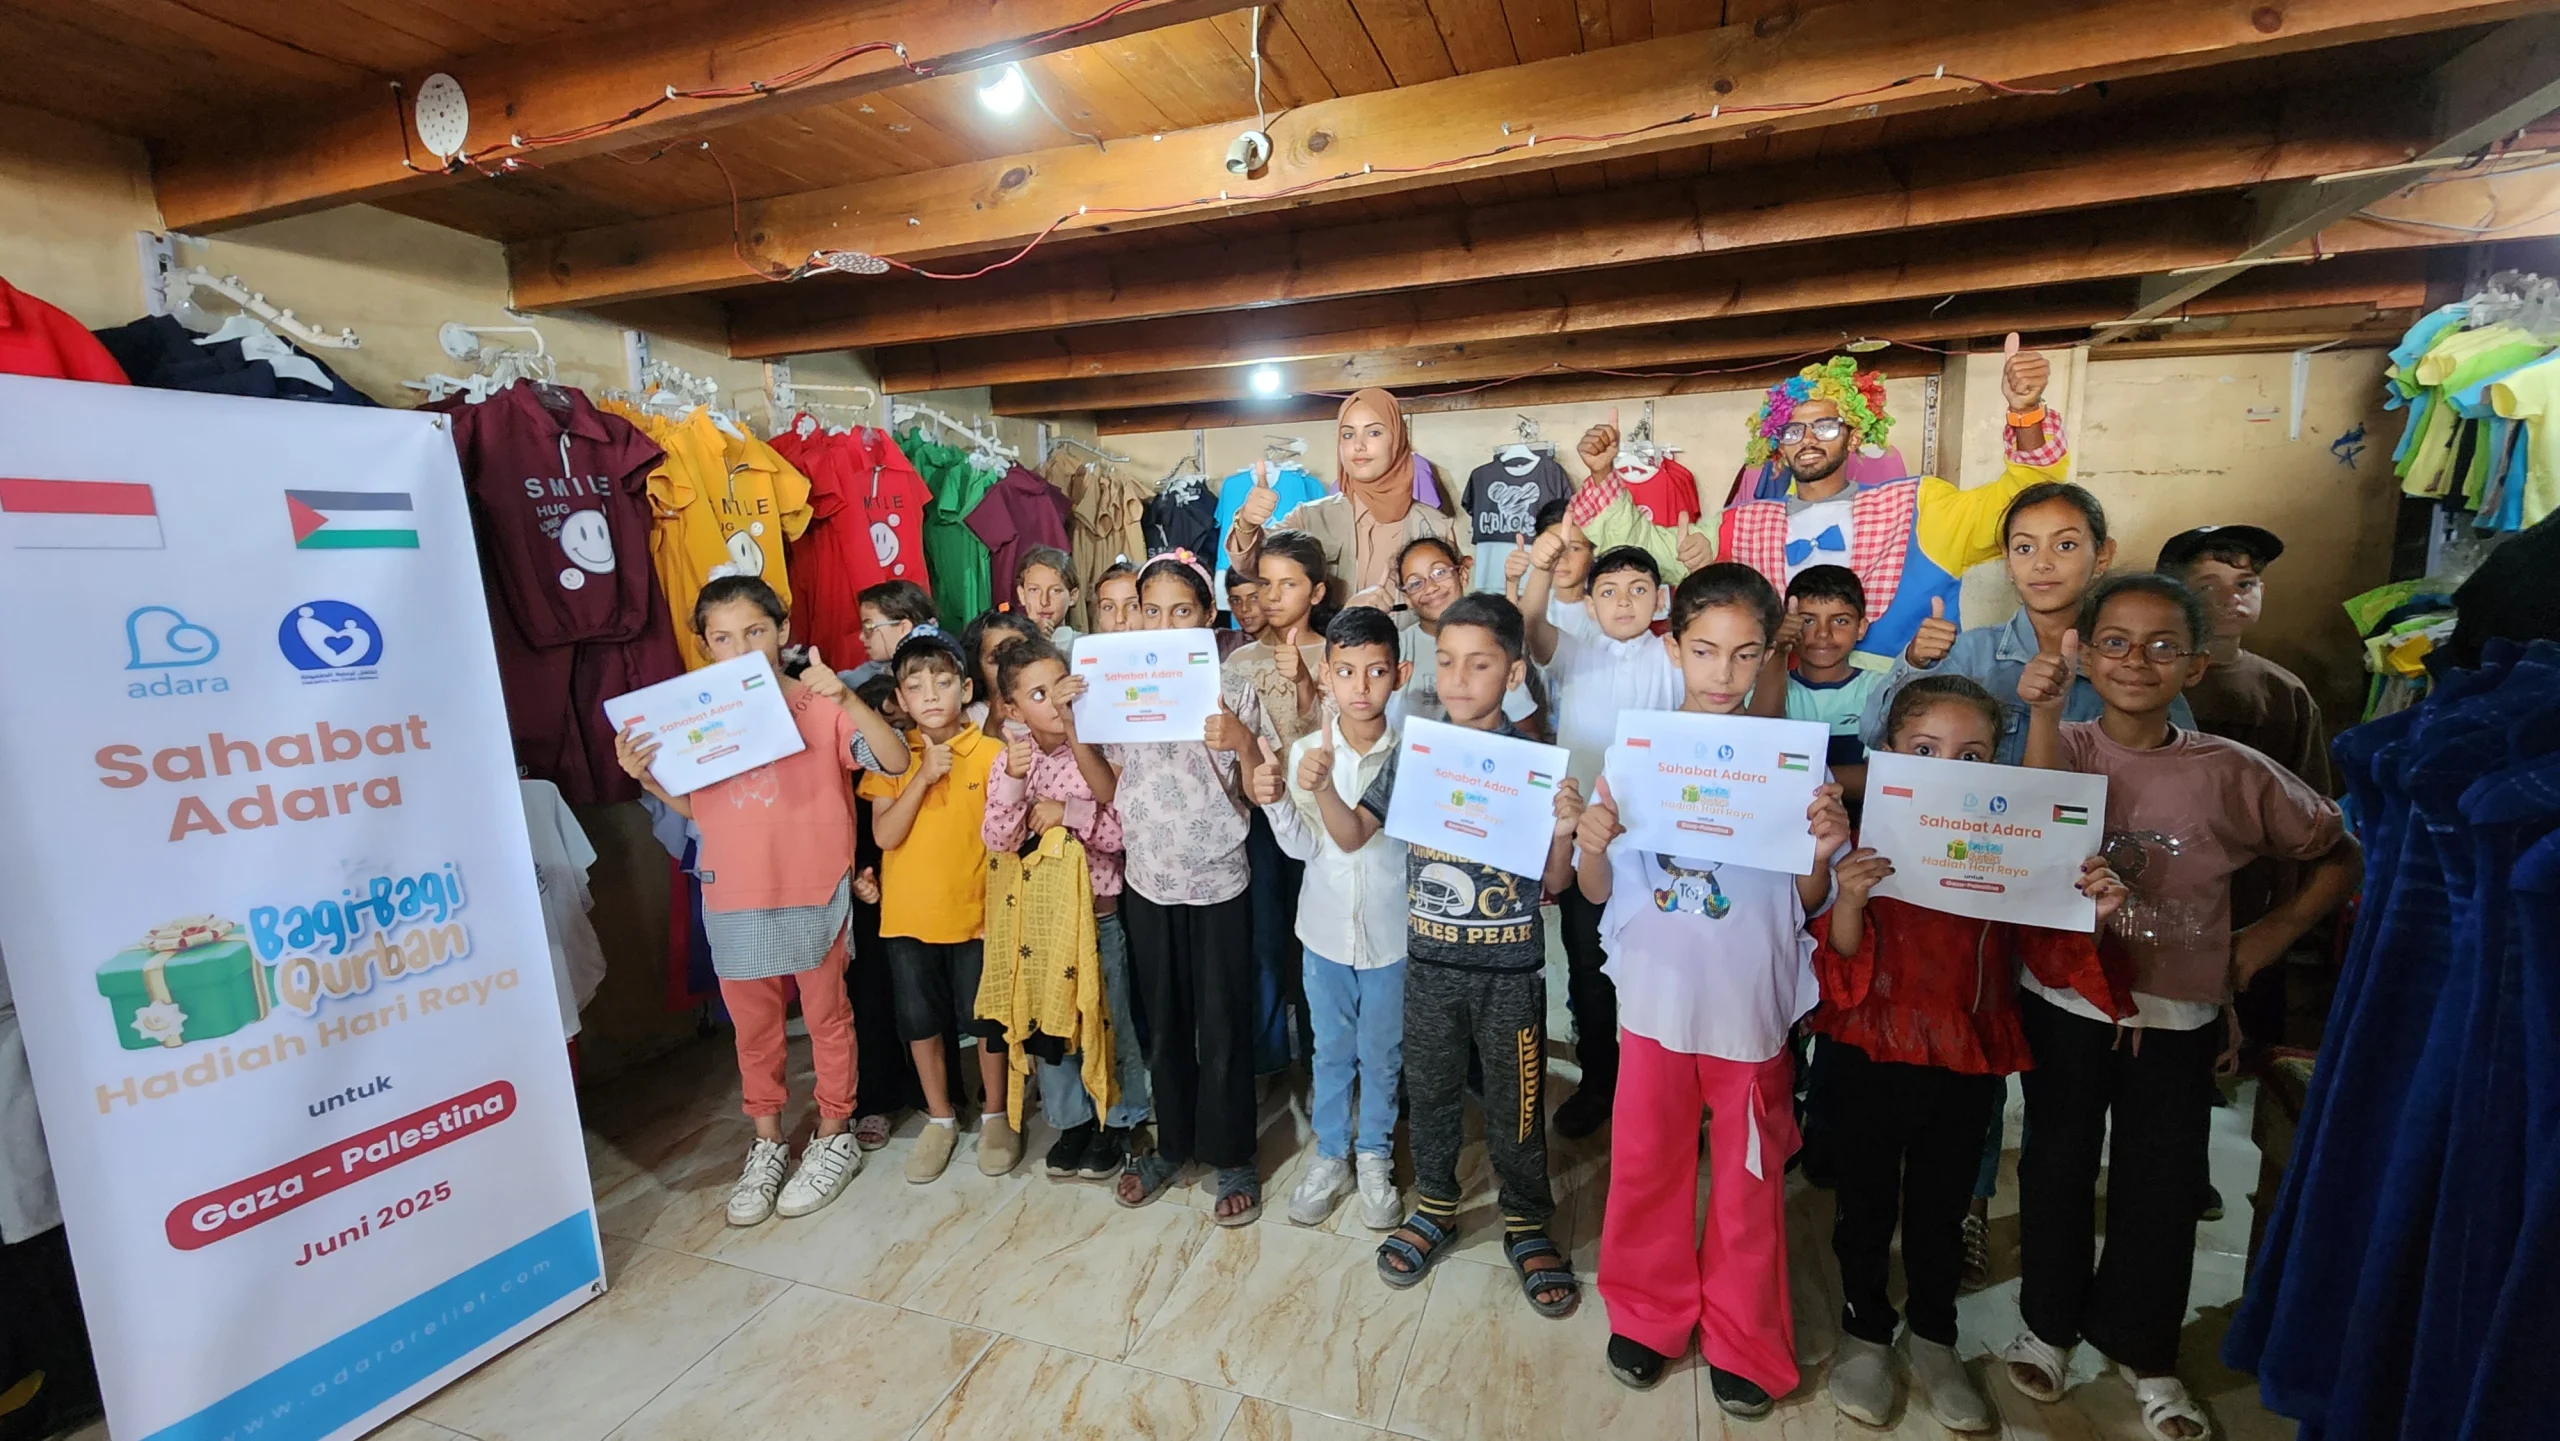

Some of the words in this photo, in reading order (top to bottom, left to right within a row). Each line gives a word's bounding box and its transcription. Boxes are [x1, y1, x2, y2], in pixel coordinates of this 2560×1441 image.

[525, 475, 611, 498] SMILE
[536, 504, 570, 517] HUG
[708, 496, 769, 516] MILE
[127, 672, 230, 699] adara
[94, 715, 431, 789] Sahabat
[1436, 768, 1480, 787] Sahabat
[1484, 780, 1518, 796] Adara
[1658, 761, 1717, 778] Sahabat
[1721, 769, 1767, 784] Adara
[168, 775, 402, 842] Adara
[1919, 814, 1988, 834] Sahabat
[1992, 823, 2042, 839] Adara
[1922, 856, 1966, 870] Hadiah
[1969, 860, 1994, 873] Hari
[1998, 865, 2029, 878] Raya
[249, 862, 459, 960] Bagi-Bagi
[1466, 923, 1533, 944] PEAK
[281, 923, 466, 1013] Qurban
[95, 1032, 306, 1114] Hadiah
[319, 998, 408, 1048] Hari
[419, 968, 519, 1016] Raya
[308, 1075, 393, 1118] untuk
[191, 1171, 304, 1233] Gaza
[342, 1090, 504, 1174] Palestina
[294, 1215, 370, 1267] Juni
[377, 1181, 452, 1230] 2025
